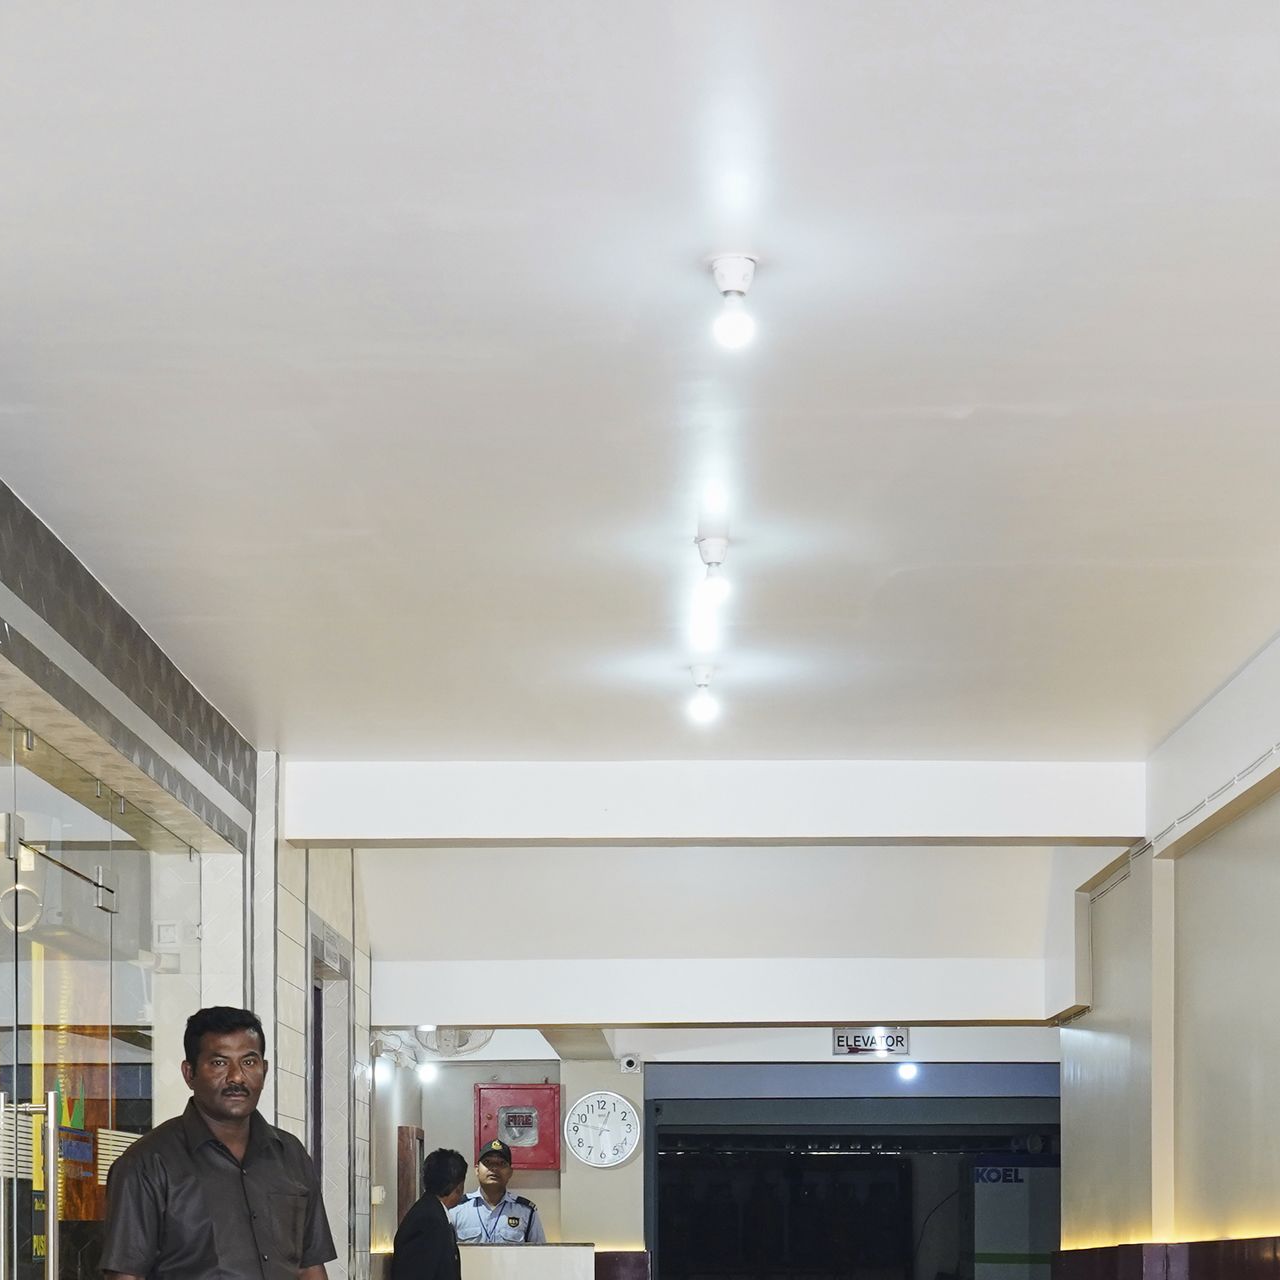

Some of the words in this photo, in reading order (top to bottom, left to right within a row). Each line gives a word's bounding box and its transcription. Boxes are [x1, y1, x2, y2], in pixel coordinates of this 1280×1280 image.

[837, 1035, 905, 1047] ELEVATOR
[586, 1104, 594, 1115] 11
[597, 1100, 606, 1110] 12
[507, 1114, 533, 1126] FIRE
[577, 1113, 587, 1124] 10
[620, 1111, 627, 1121] 2
[572, 1125, 579, 1135] 9
[625, 1123, 632, 1133] 3
[577, 1138, 584, 1148] 8
[587, 1145, 594, 1156] 7
[600, 1149, 607, 1159] 6
[612, 1145, 619, 1156] 5
[975, 1168, 1025, 1183] KOEL
